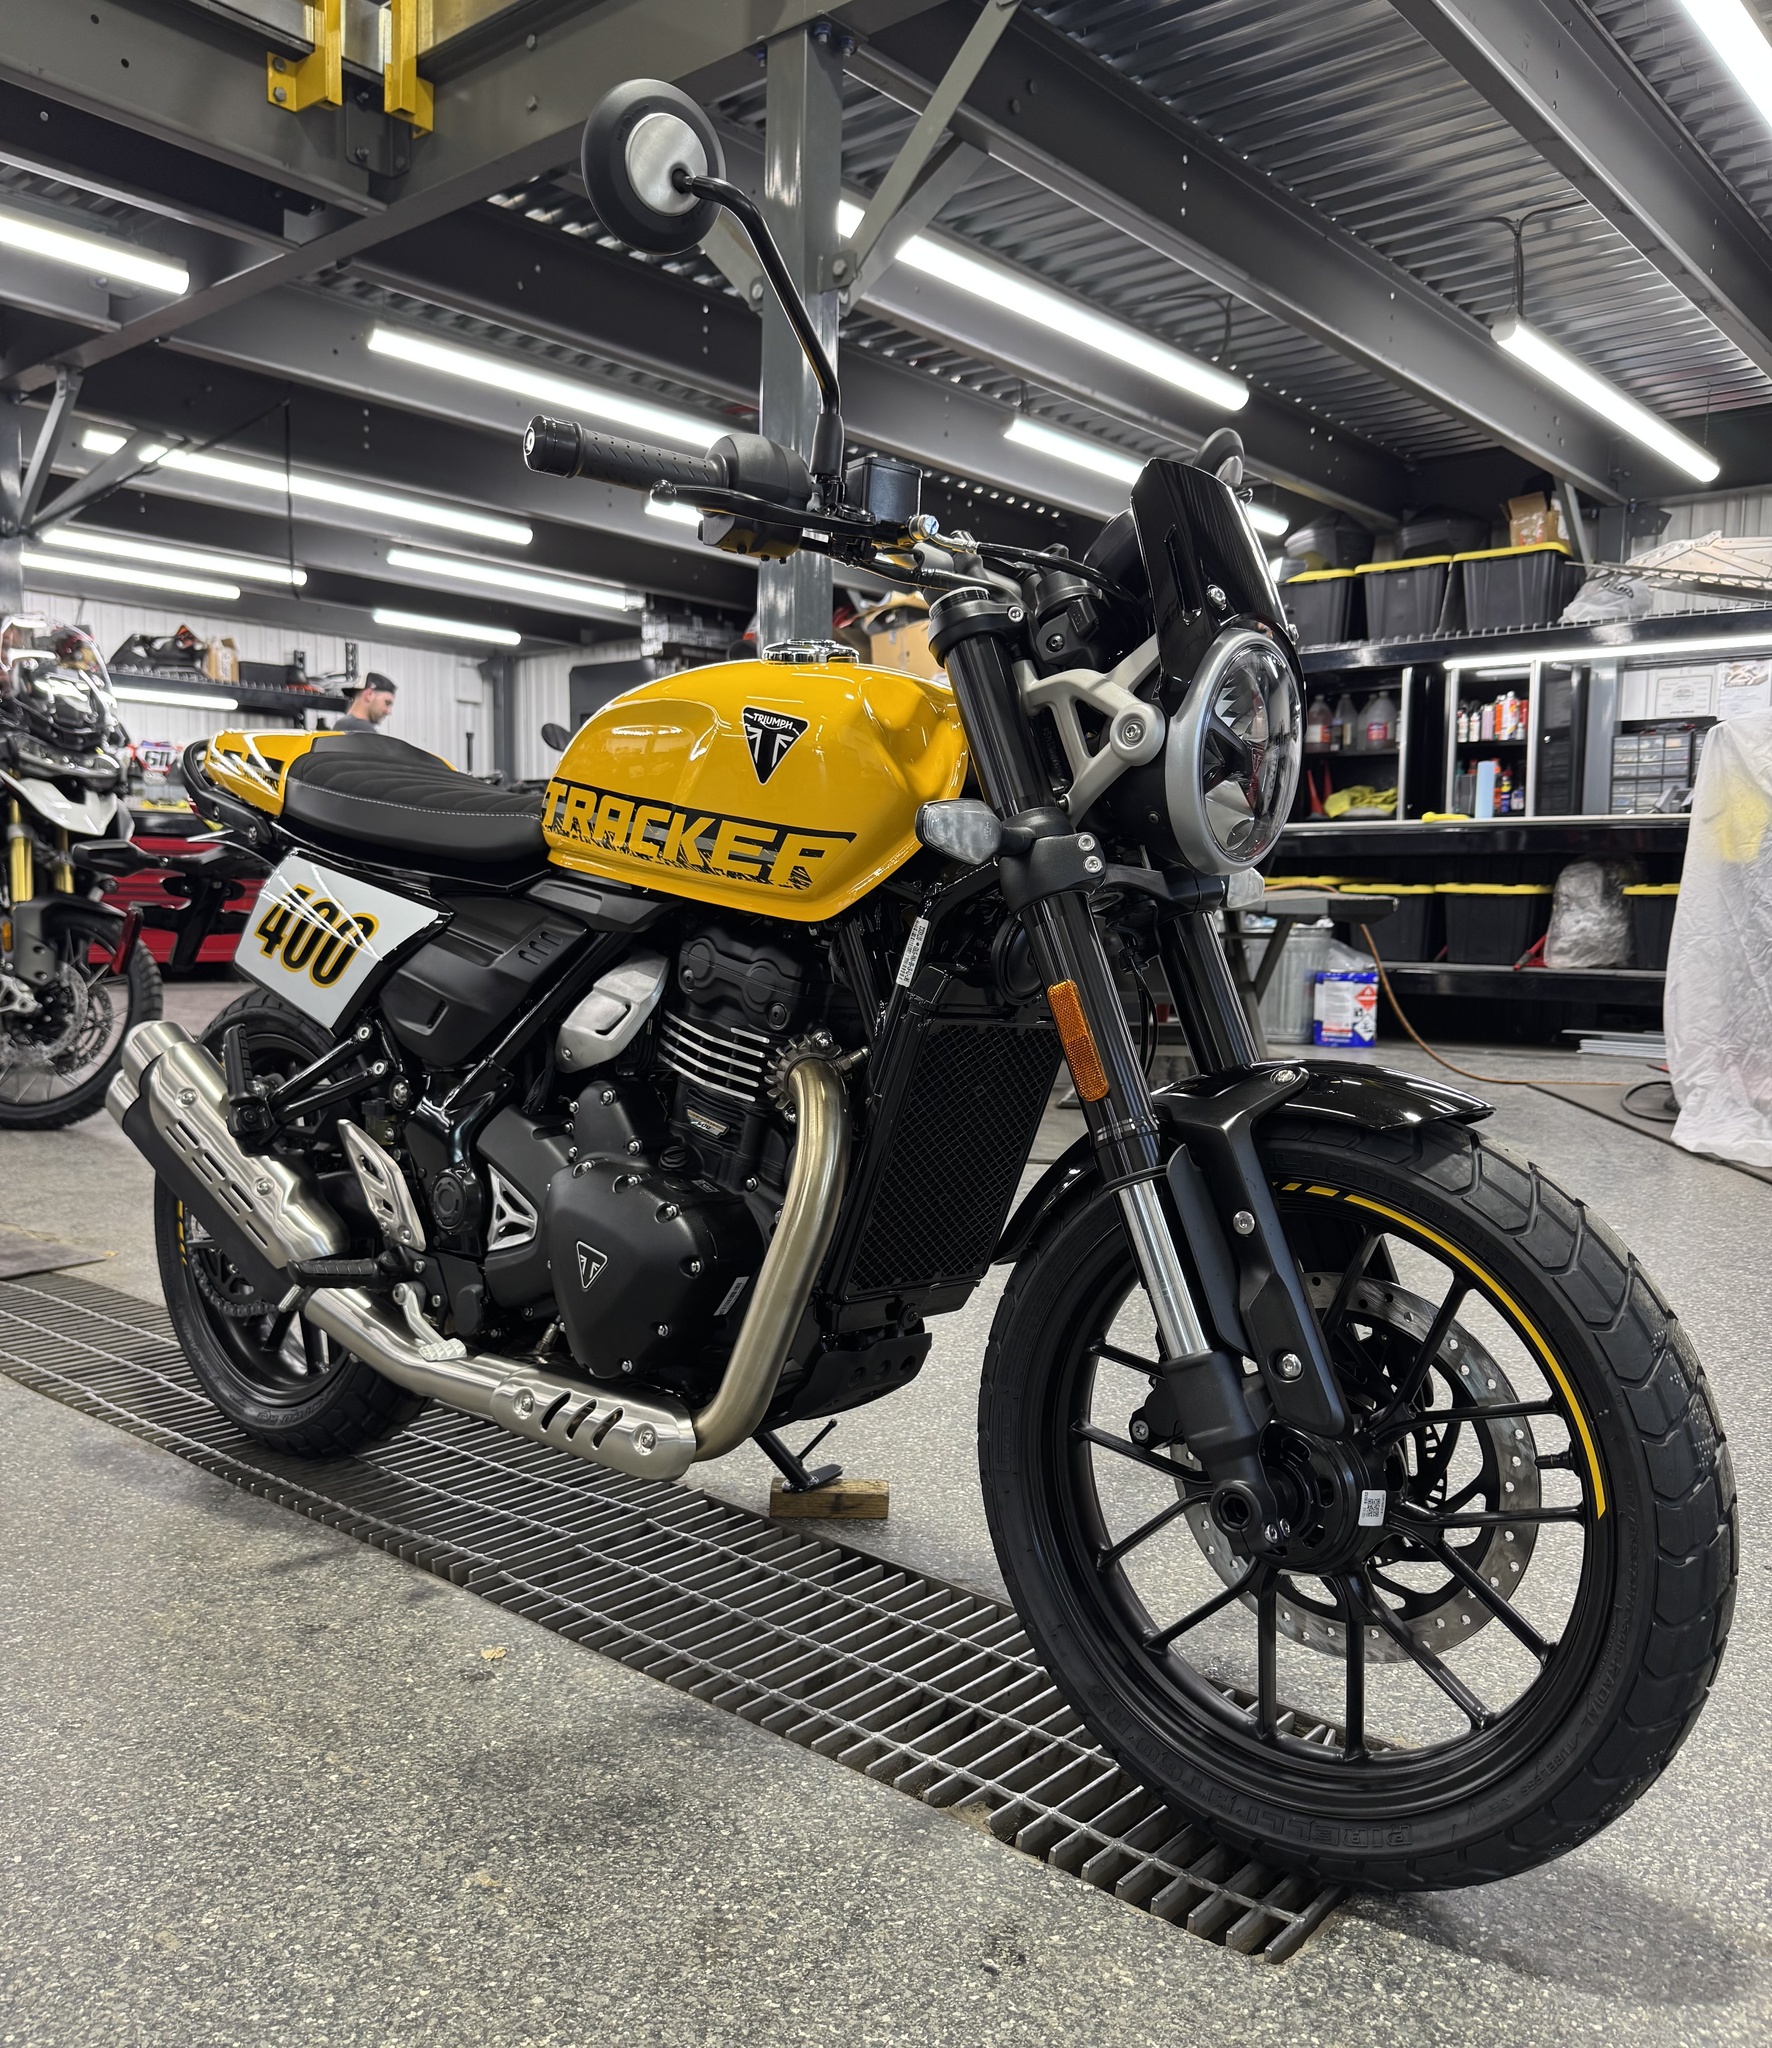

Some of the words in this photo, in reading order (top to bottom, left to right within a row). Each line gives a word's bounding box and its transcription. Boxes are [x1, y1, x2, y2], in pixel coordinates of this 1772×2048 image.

[753, 712, 793, 730] TRIUMPH
[544, 782, 852, 887] TRACKER
[253, 883, 379, 988] 400
[1247, 1804, 1412, 1848] PIRELLI
